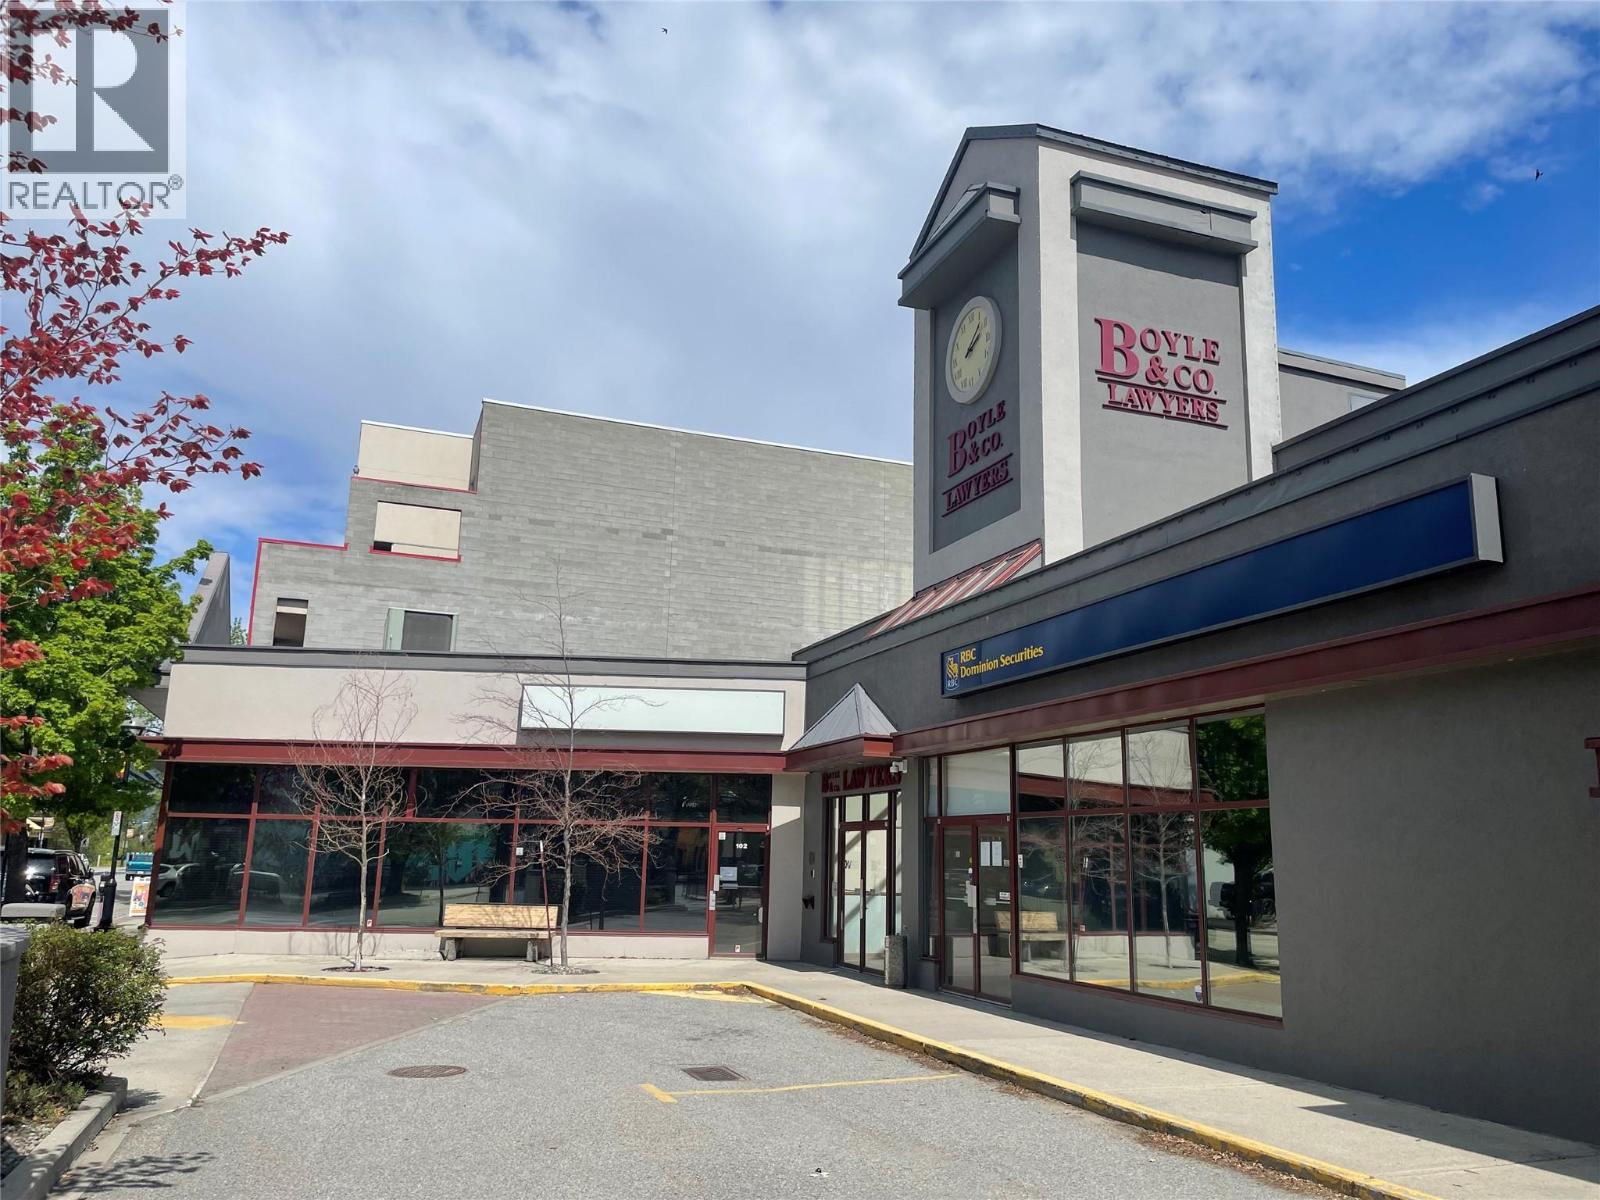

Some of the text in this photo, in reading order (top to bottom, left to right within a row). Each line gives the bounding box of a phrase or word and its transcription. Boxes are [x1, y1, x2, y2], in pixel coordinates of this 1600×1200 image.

[1094, 317, 1221, 380] BOYLE
[1107, 383, 1221, 423] LAWYERS
[947, 400, 1006, 478] BOYLE
[944, 459, 1009, 511] LAWYERS
[960, 647, 977, 664] RBC
[960, 645, 1044, 679] Dominion Securities
[947, 677, 958, 688] RBC
